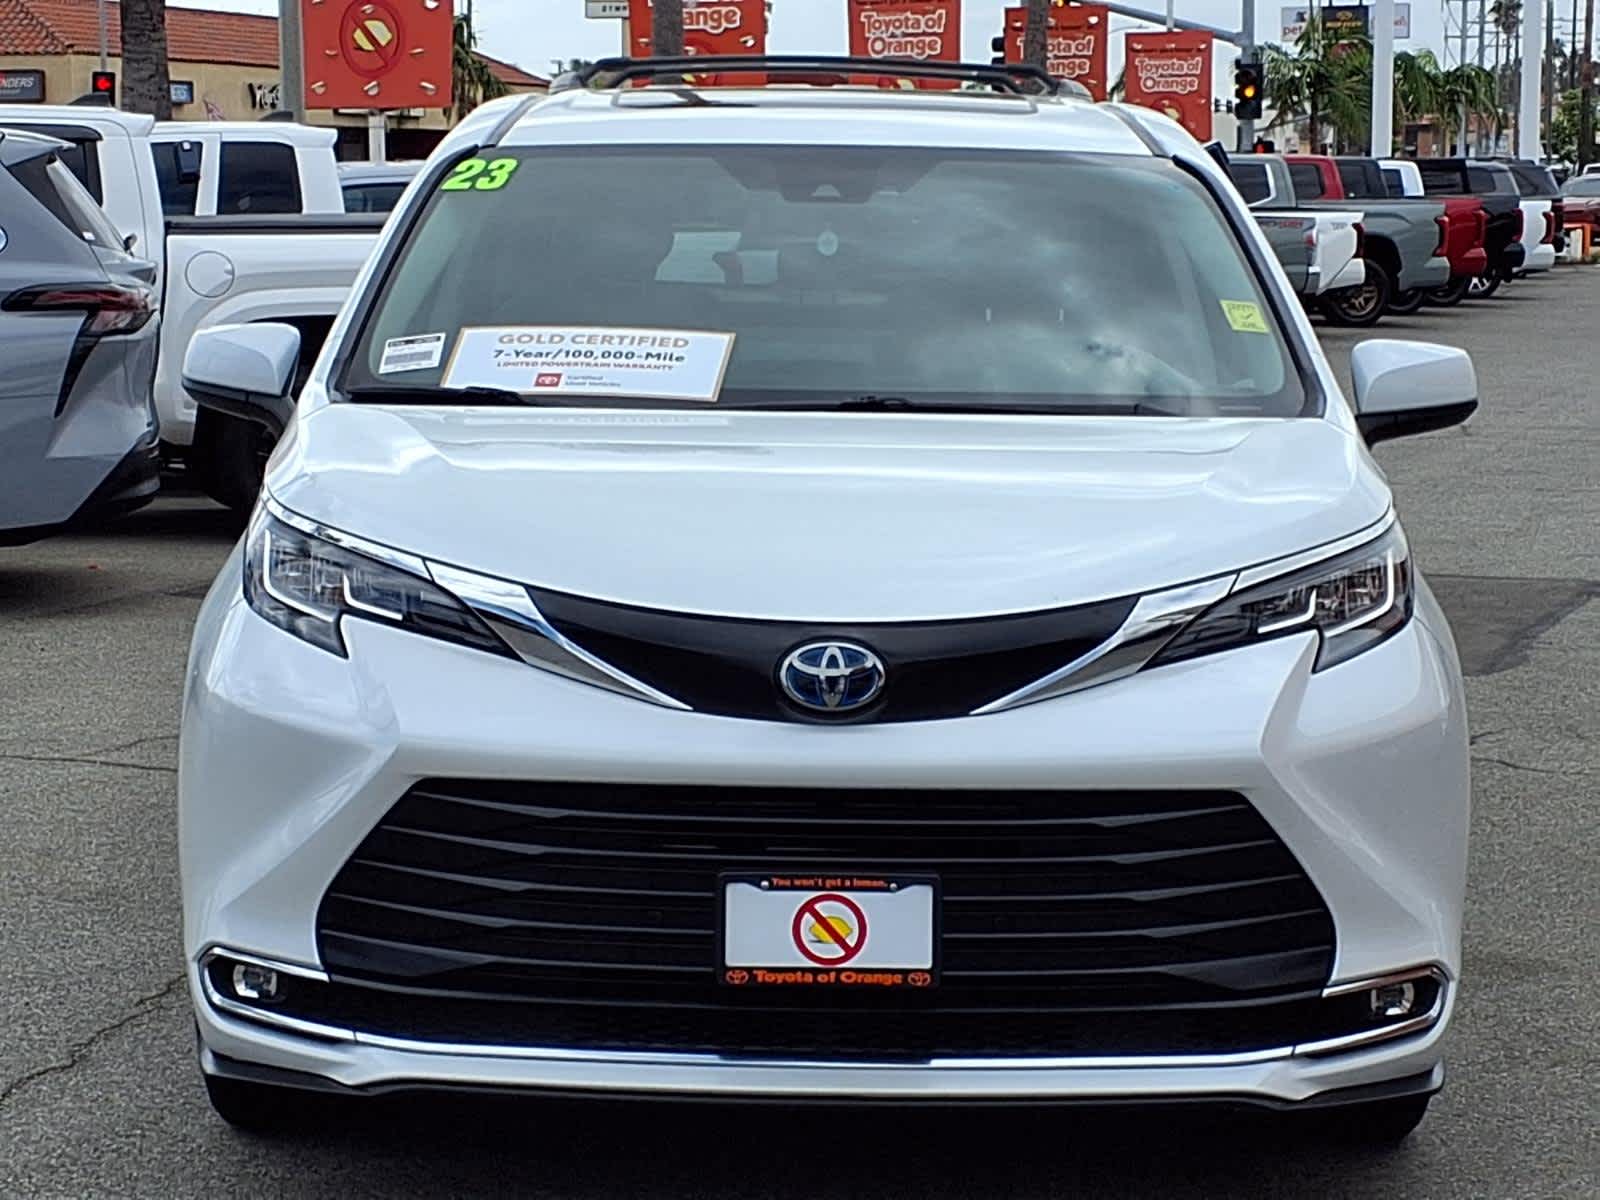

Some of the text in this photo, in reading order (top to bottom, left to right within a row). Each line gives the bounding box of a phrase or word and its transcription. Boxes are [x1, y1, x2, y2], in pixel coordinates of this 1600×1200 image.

[683, 7, 741, 32] ange
[861, 9, 945, 37] Toyota of
[869, 37, 941, 59] Orange
[1074, 35, 1094, 55] of
[1046, 60, 1089, 77] ange
[1136, 56, 1202, 77] Toyota of
[1141, 76, 1199, 94] Orange
[440, 158, 519, 191] 23
[498, 333, 690, 349] GOLD CERTIFIED
[493, 348, 686, 363] 7-Year/100,000-Mile
[613, 362, 674, 371] WARRANTY
[771, 878, 791, 887] You
[752, 970, 903, 986] Toyota of Orange
